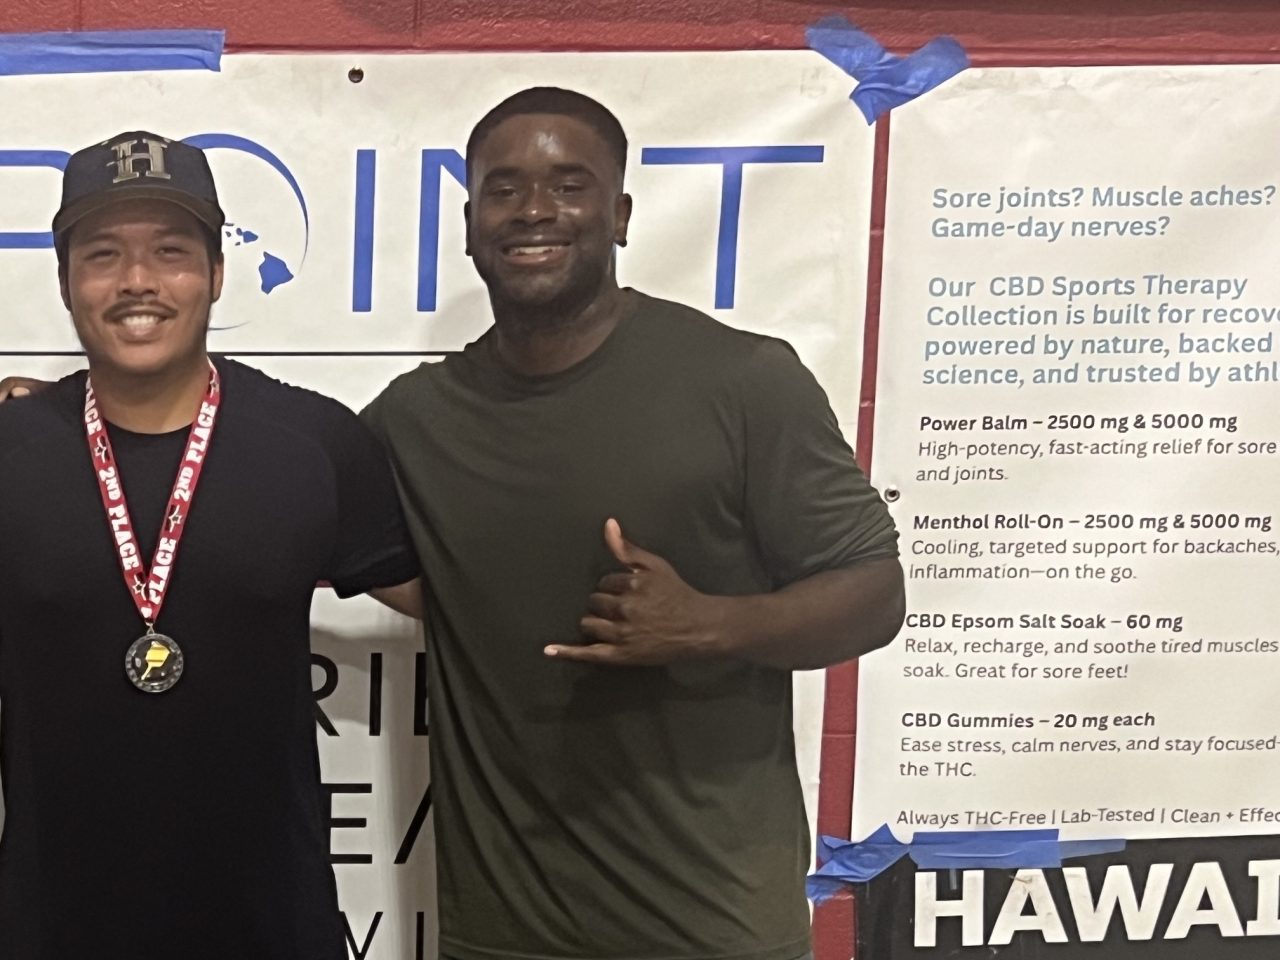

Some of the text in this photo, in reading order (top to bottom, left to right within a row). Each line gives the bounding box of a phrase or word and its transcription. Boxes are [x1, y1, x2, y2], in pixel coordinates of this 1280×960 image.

[933, 185, 1276, 214] Sore joints? Muscle aches?
[932, 216, 1170, 243] Game-day nerves?
[929, 274, 1248, 301] Our CBD Sports Therapy
[927, 305, 1057, 326] Collection
[1066, 305, 1084, 324] is
[1093, 304, 1151, 324] built
[1158, 303, 1195, 323] for
[925, 332, 1272, 361] powered by nature, backed
[923, 361, 1278, 389] science, and trusted by athl
[920, 417, 977, 430] Power
[982, 415, 1027, 430] Balm
[1048, 415, 1095, 429] 2500
[1101, 417, 1128, 433] mg
[1133, 414, 1145, 428] &
[1152, 414, 1203, 428] 5000
[1210, 417, 1237, 432] mg
[174, 401, 216, 503] 2ND PLACE
[919, 439, 1276, 460] High-potency, fast-acting relief for sore
[916, 466, 1008, 485] and joints.
[99, 467, 139, 571] 2ND PLACE
[914, 514, 988, 529] Menthol
[995, 514, 1063, 528] Roll-On
[1084, 515, 1133, 528] 2500
[1140, 517, 1168, 532] mg
[1173, 515, 1184, 528] &
[1191, 514, 1239, 528] 5000
[1245, 516, 1271, 532] mg
[912, 539, 1279, 558] Cooling, targeted support for backaches,
[1076, 564, 1105, 579] the
[1111, 567, 1136, 583] go.
[906, 614, 945, 627] CBD
[952, 614, 1013, 631] Epsom
[1020, 614, 1056, 628] Salt
[1061, 614, 1105, 628] Soak
[1127, 615, 1150, 629] 60
[1156, 617, 1182, 632] mg
[906, 638, 1278, 657] Relax, recharge, and soothe tired muscles
[904, 663, 1127, 678] soak. Great for sore feet!
[902, 713, 941, 727] CBD
[948, 713, 1034, 728] Gummies
[1054, 714, 1077, 728] 20
[1082, 716, 1108, 731] mg
[1113, 712, 1155, 726] each
[901, 738, 941, 752] Ease
[948, 740, 1005, 754] stress,
[1012, 738, 1054, 752] calm
[1060, 740, 1120, 752] nerves,
[1126, 736, 1159, 750] and
[1165, 739, 1203, 755] stay
[900, 762, 976, 776] the THC.
[897, 810, 958, 828] Always
[965, 811, 1046, 825] THC-Free
[1061, 808, 1155, 823] Lab-Tested
[1171, 809, 1220, 823] Clean
[914, 858, 1280, 948] HAWAI
